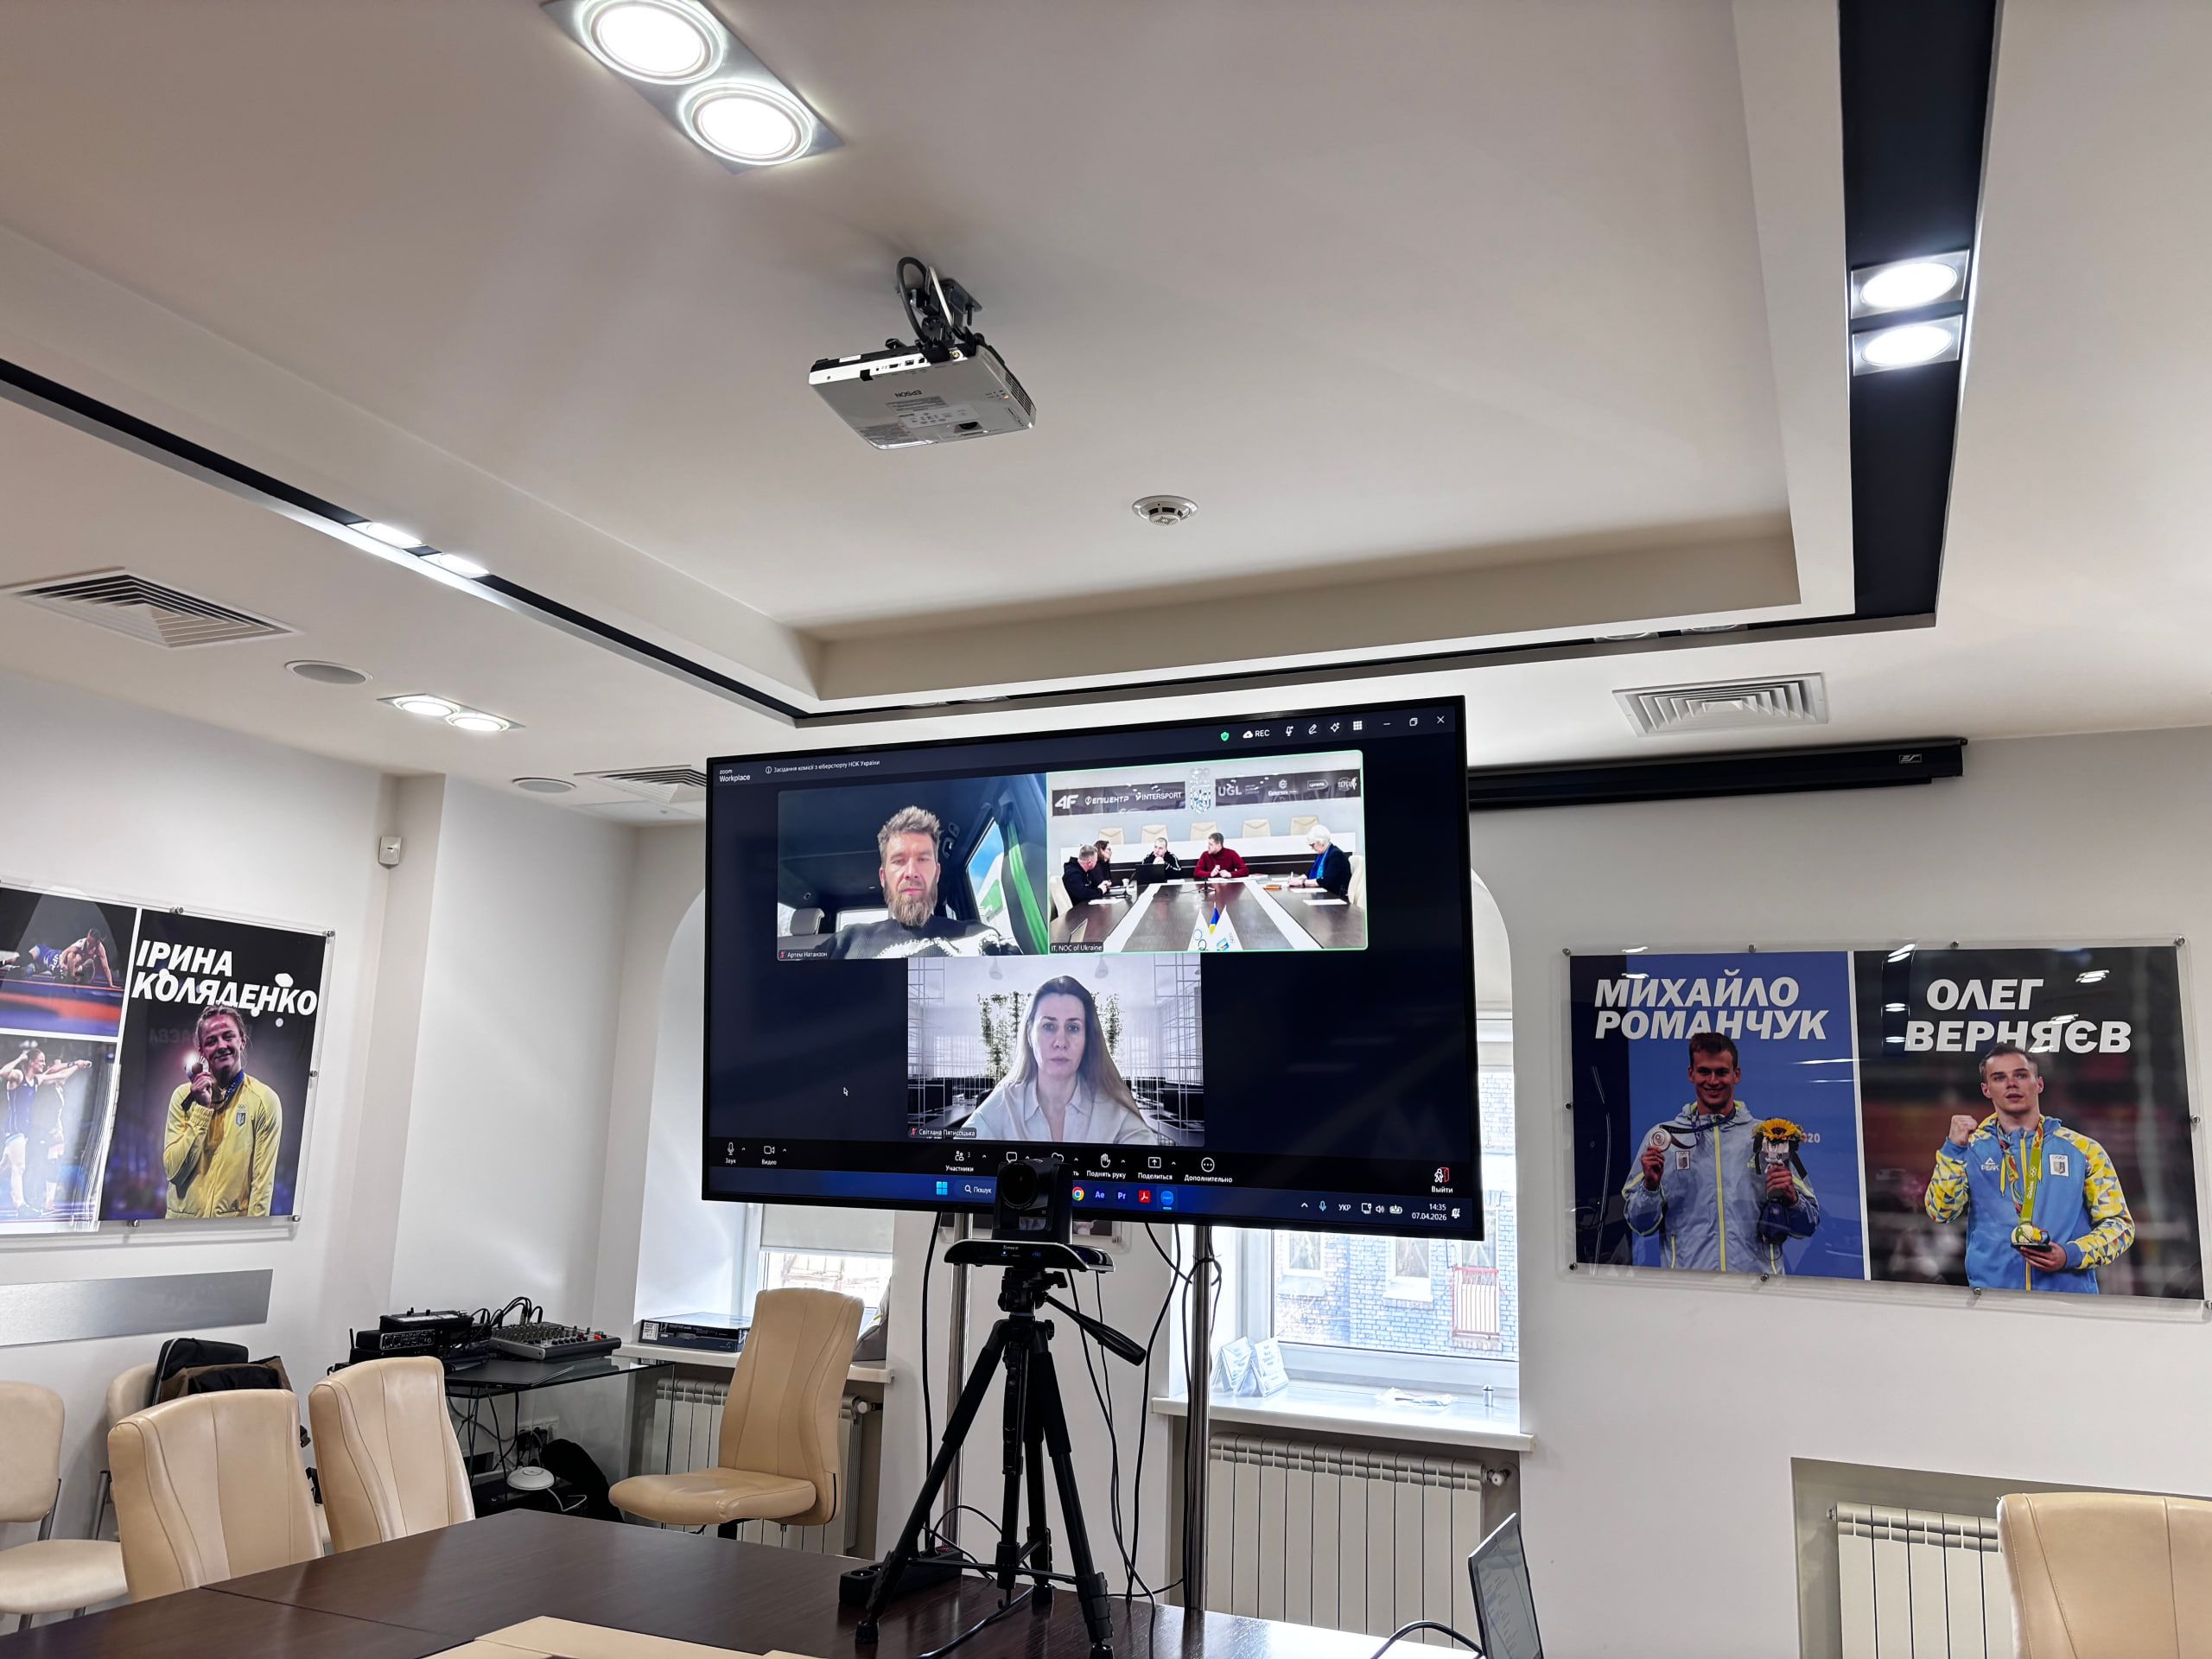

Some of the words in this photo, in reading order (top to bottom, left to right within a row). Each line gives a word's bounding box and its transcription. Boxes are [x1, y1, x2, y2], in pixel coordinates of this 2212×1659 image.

[894, 389, 923, 397] EPSON
[719, 774, 751, 783] Workplace
[1141, 791, 1182, 801] INTERSPORT
[1217, 785, 1243, 797] UGL
[1055, 794, 1079, 810] 4F
[136, 939, 233, 977] ІРИНА
[131, 971, 318, 1016] КОЛЯДЕНКО
[1594, 969, 1799, 1007] МИХАЙЛО
[1927, 978, 2044, 1011] ОЛЕГ
[1595, 1009, 1828, 1041] РОМАНЧУК
[1904, 1020, 2132, 1053] ВЕРНЯЄВ
[1184, 1174, 1233, 1184] Дополнительно
[1412, 1212, 1447, 1221] 07.04.2026
